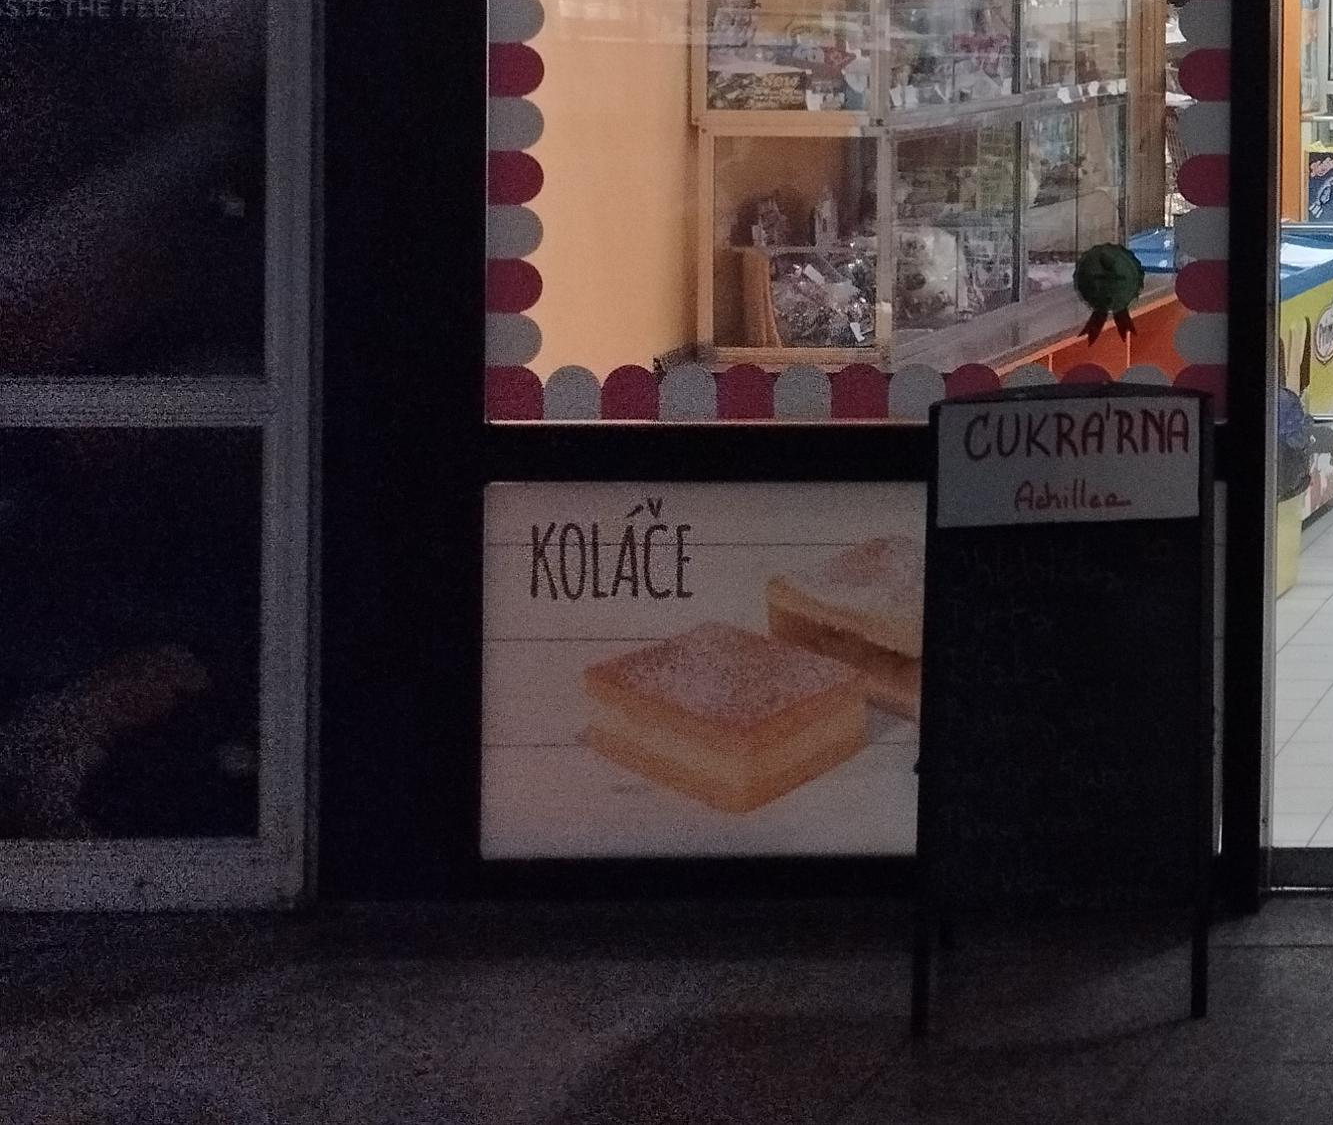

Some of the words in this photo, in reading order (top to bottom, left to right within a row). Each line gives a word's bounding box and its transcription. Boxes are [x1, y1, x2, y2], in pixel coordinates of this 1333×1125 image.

[0, 0, 51, 18] STE
[59, 0, 110, 18] THE
[1014, 478, 1131, 512] Achillea
[530, 498, 693, 600] KOLÁČE
